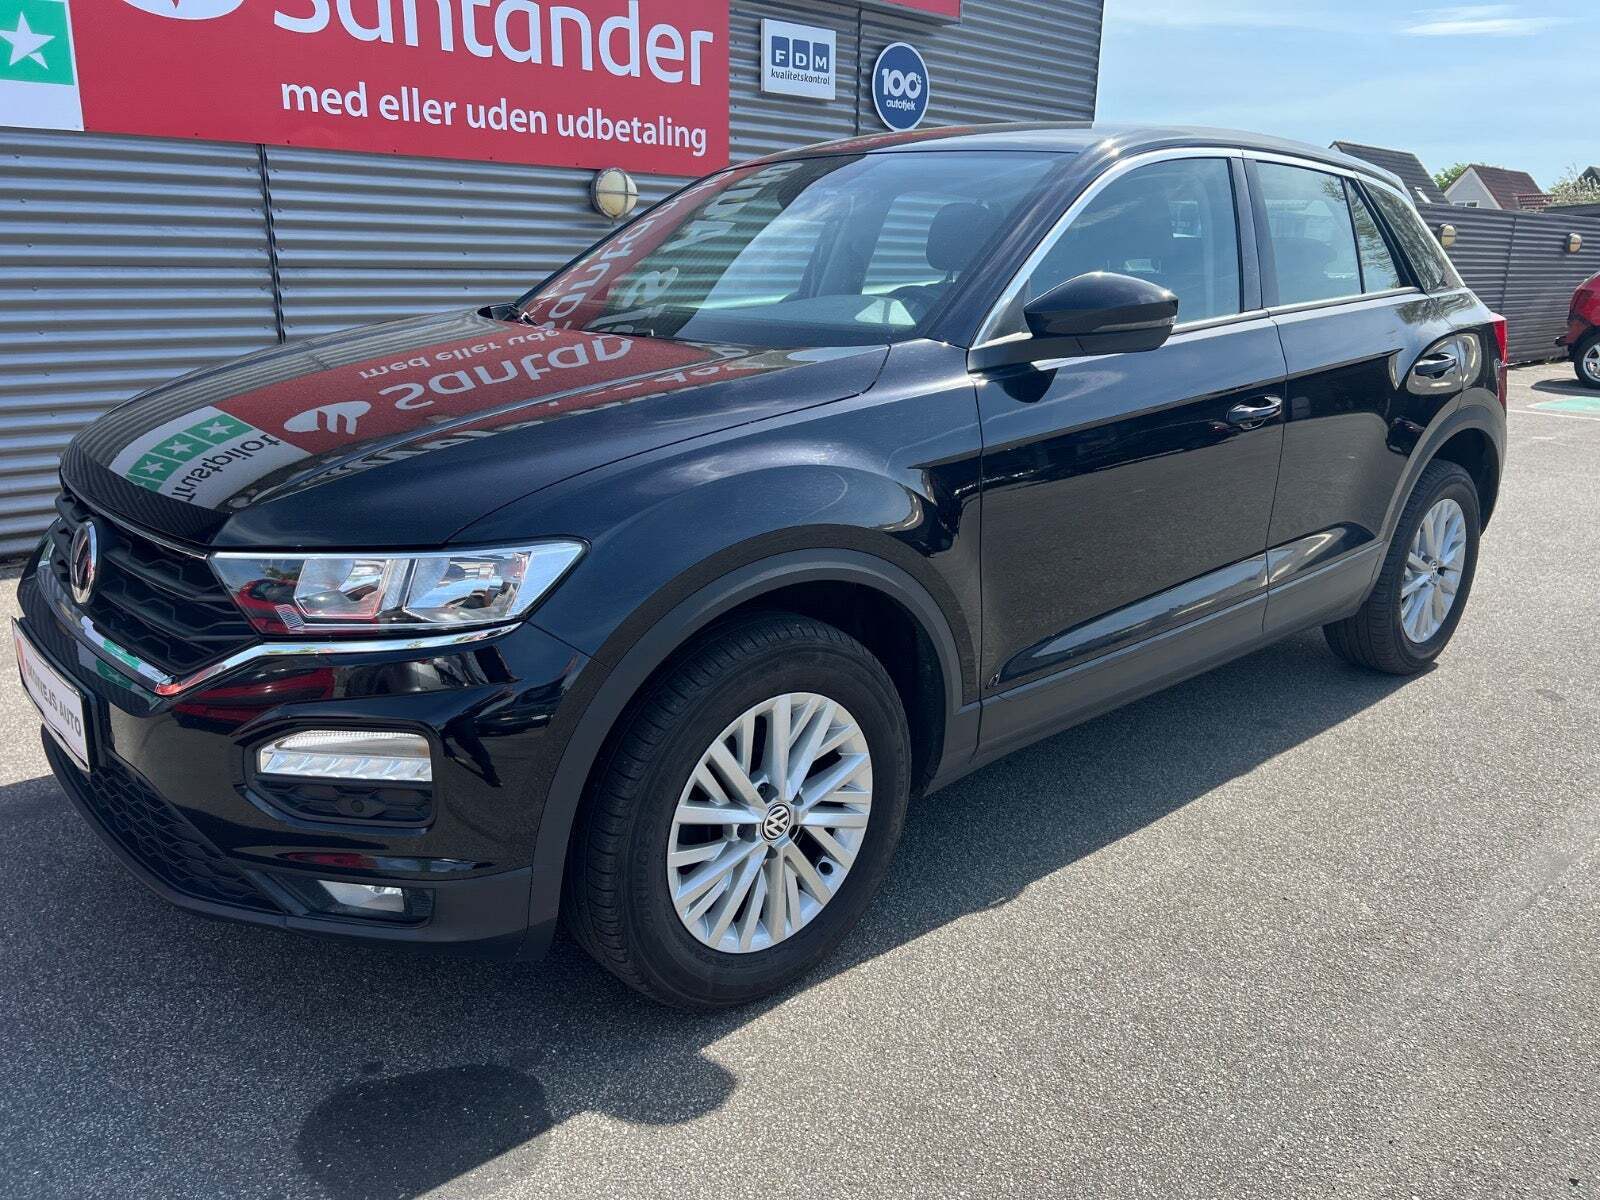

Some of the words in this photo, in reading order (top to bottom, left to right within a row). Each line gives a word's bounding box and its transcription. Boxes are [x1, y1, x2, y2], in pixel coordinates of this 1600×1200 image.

[775, 49, 828, 70] FDM
[770, 67, 831, 86] kvalitetskontrol
[281, 81, 368, 117] med
[379, 86, 456, 125] eller
[466, 98, 548, 135] uden
[557, 107, 707, 157] udbetaling
[59, 700, 82, 737] AUTO
